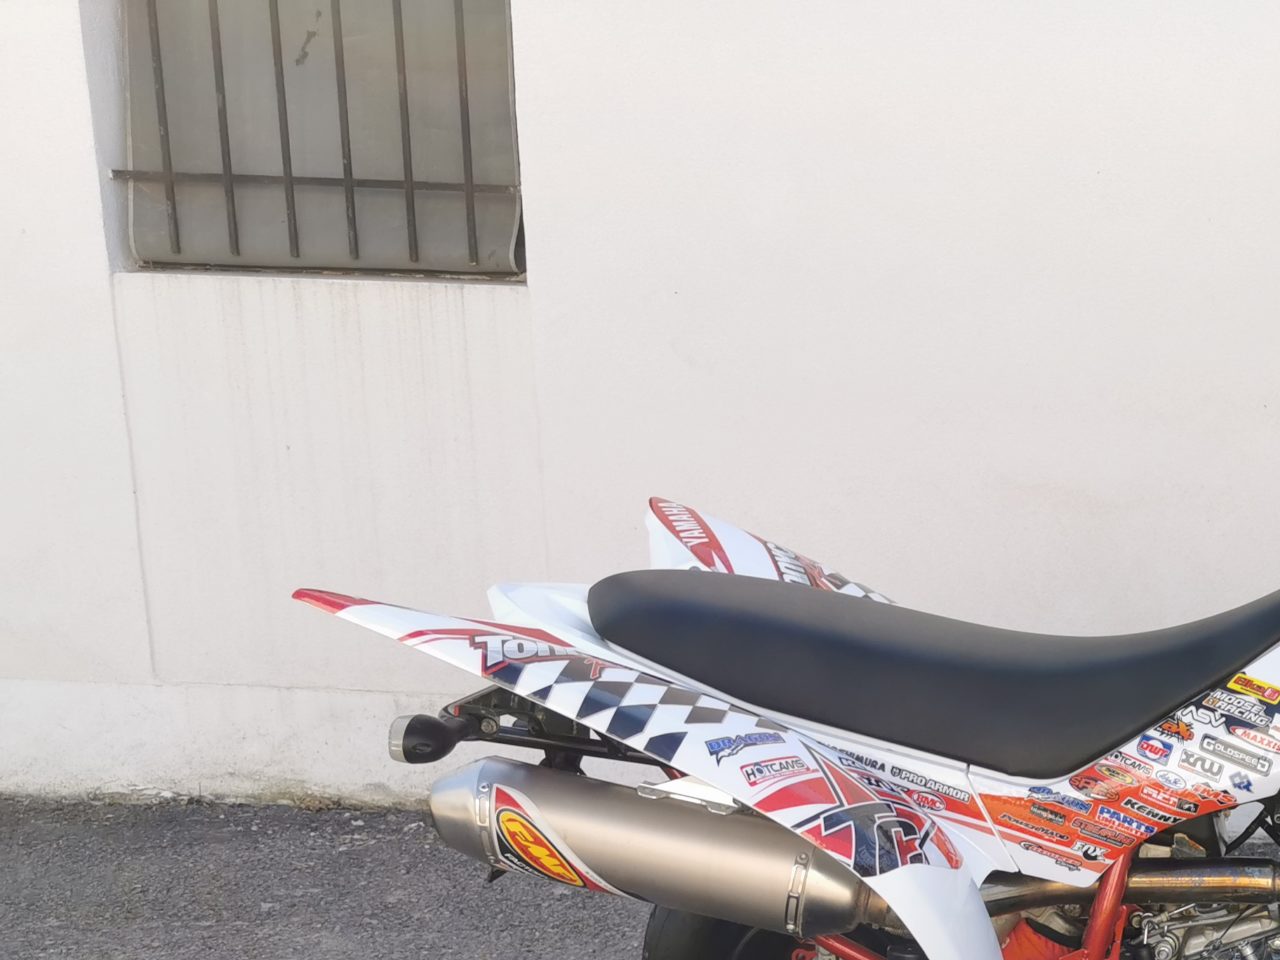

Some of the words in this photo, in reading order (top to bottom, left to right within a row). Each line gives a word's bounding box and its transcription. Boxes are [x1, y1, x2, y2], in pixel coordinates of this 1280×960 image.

[658, 501, 710, 548] YAMAHA
[1213, 689, 1263, 713] MOOSE
[1216, 702, 1271, 727] RACING
[1201, 737, 1271, 772] GOLDSPEED
[745, 759, 805, 781] HOTCAMS
[901, 771, 927, 787] PRO
[926, 780, 970, 802] ARMOR
[1099, 806, 1157, 834] PARTS
[1124, 798, 1183, 824] KENNY
[501, 817, 579, 883] FMF
